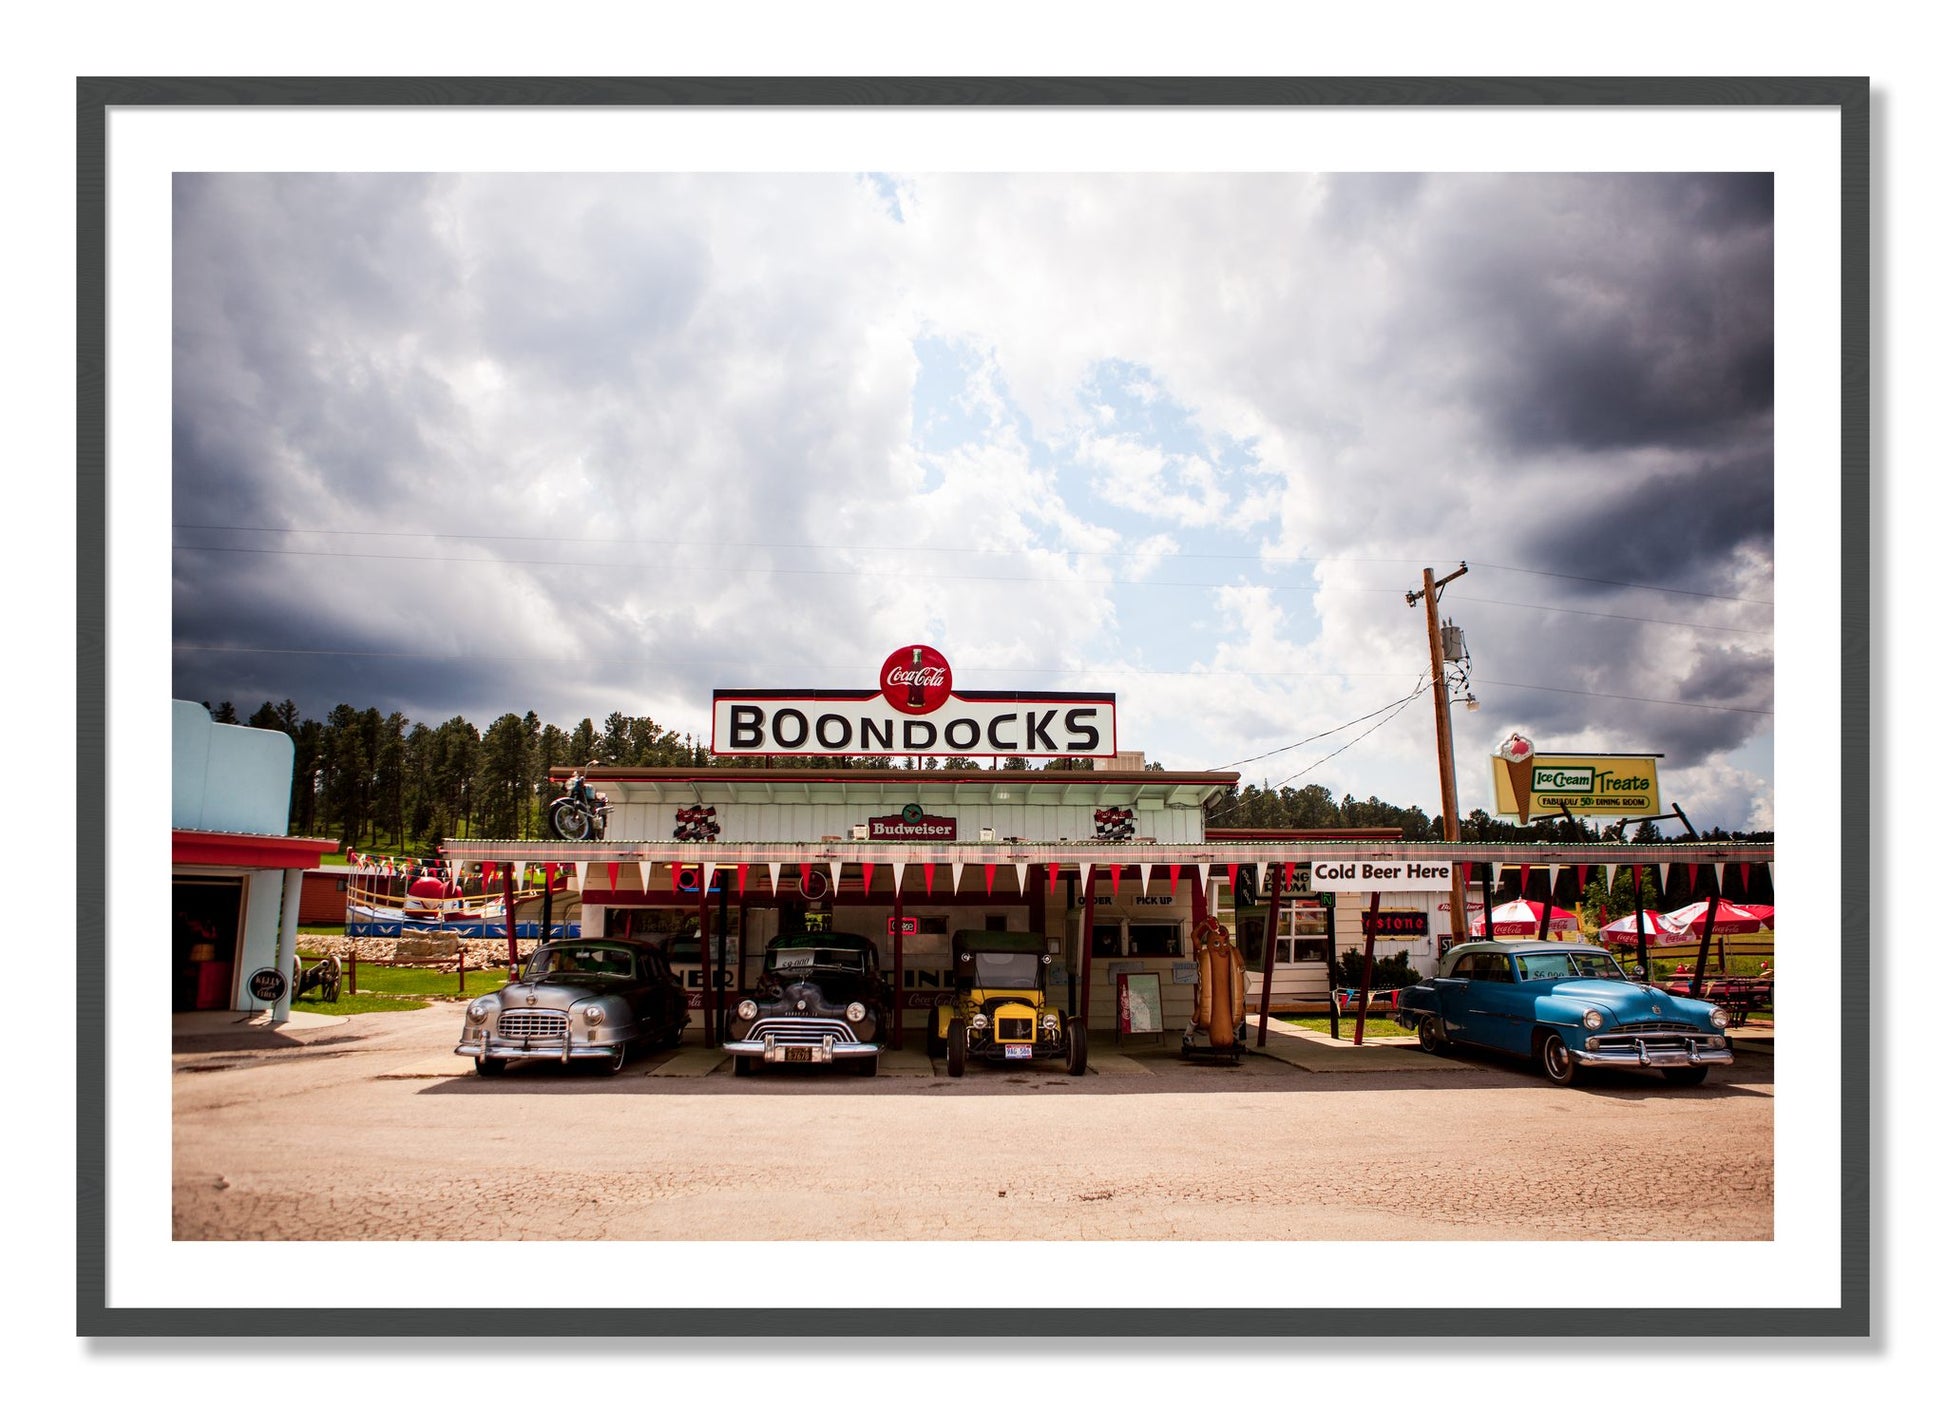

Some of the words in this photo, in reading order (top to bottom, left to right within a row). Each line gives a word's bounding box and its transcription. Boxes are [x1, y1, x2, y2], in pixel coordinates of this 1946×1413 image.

[887, 665, 947, 687] Coca-Cola
[729, 704, 1101, 751] BOONDOCKS
[1536, 772, 1553, 785] Ice
[1553, 772, 1590, 788] Cream
[1595, 771, 1650, 793] Treats
[1542, 798, 1579, 806] FABULOUS
[1596, 798, 1621, 806] DINING
[1622, 798, 1645, 806] ROOM
[872, 823, 952, 835] Budweiser
[1314, 863, 1356, 880] Cold
[1362, 863, 1402, 879] Beer
[1407, 863, 1449, 879] Here
[1077, 896, 1112, 905] ODER
[1136, 896, 1158, 905] PICK
[1159, 896, 1173, 905] UP
[1549, 920, 1568, 930] oca-Cola
[1534, 970, 1564, 979] $6000
